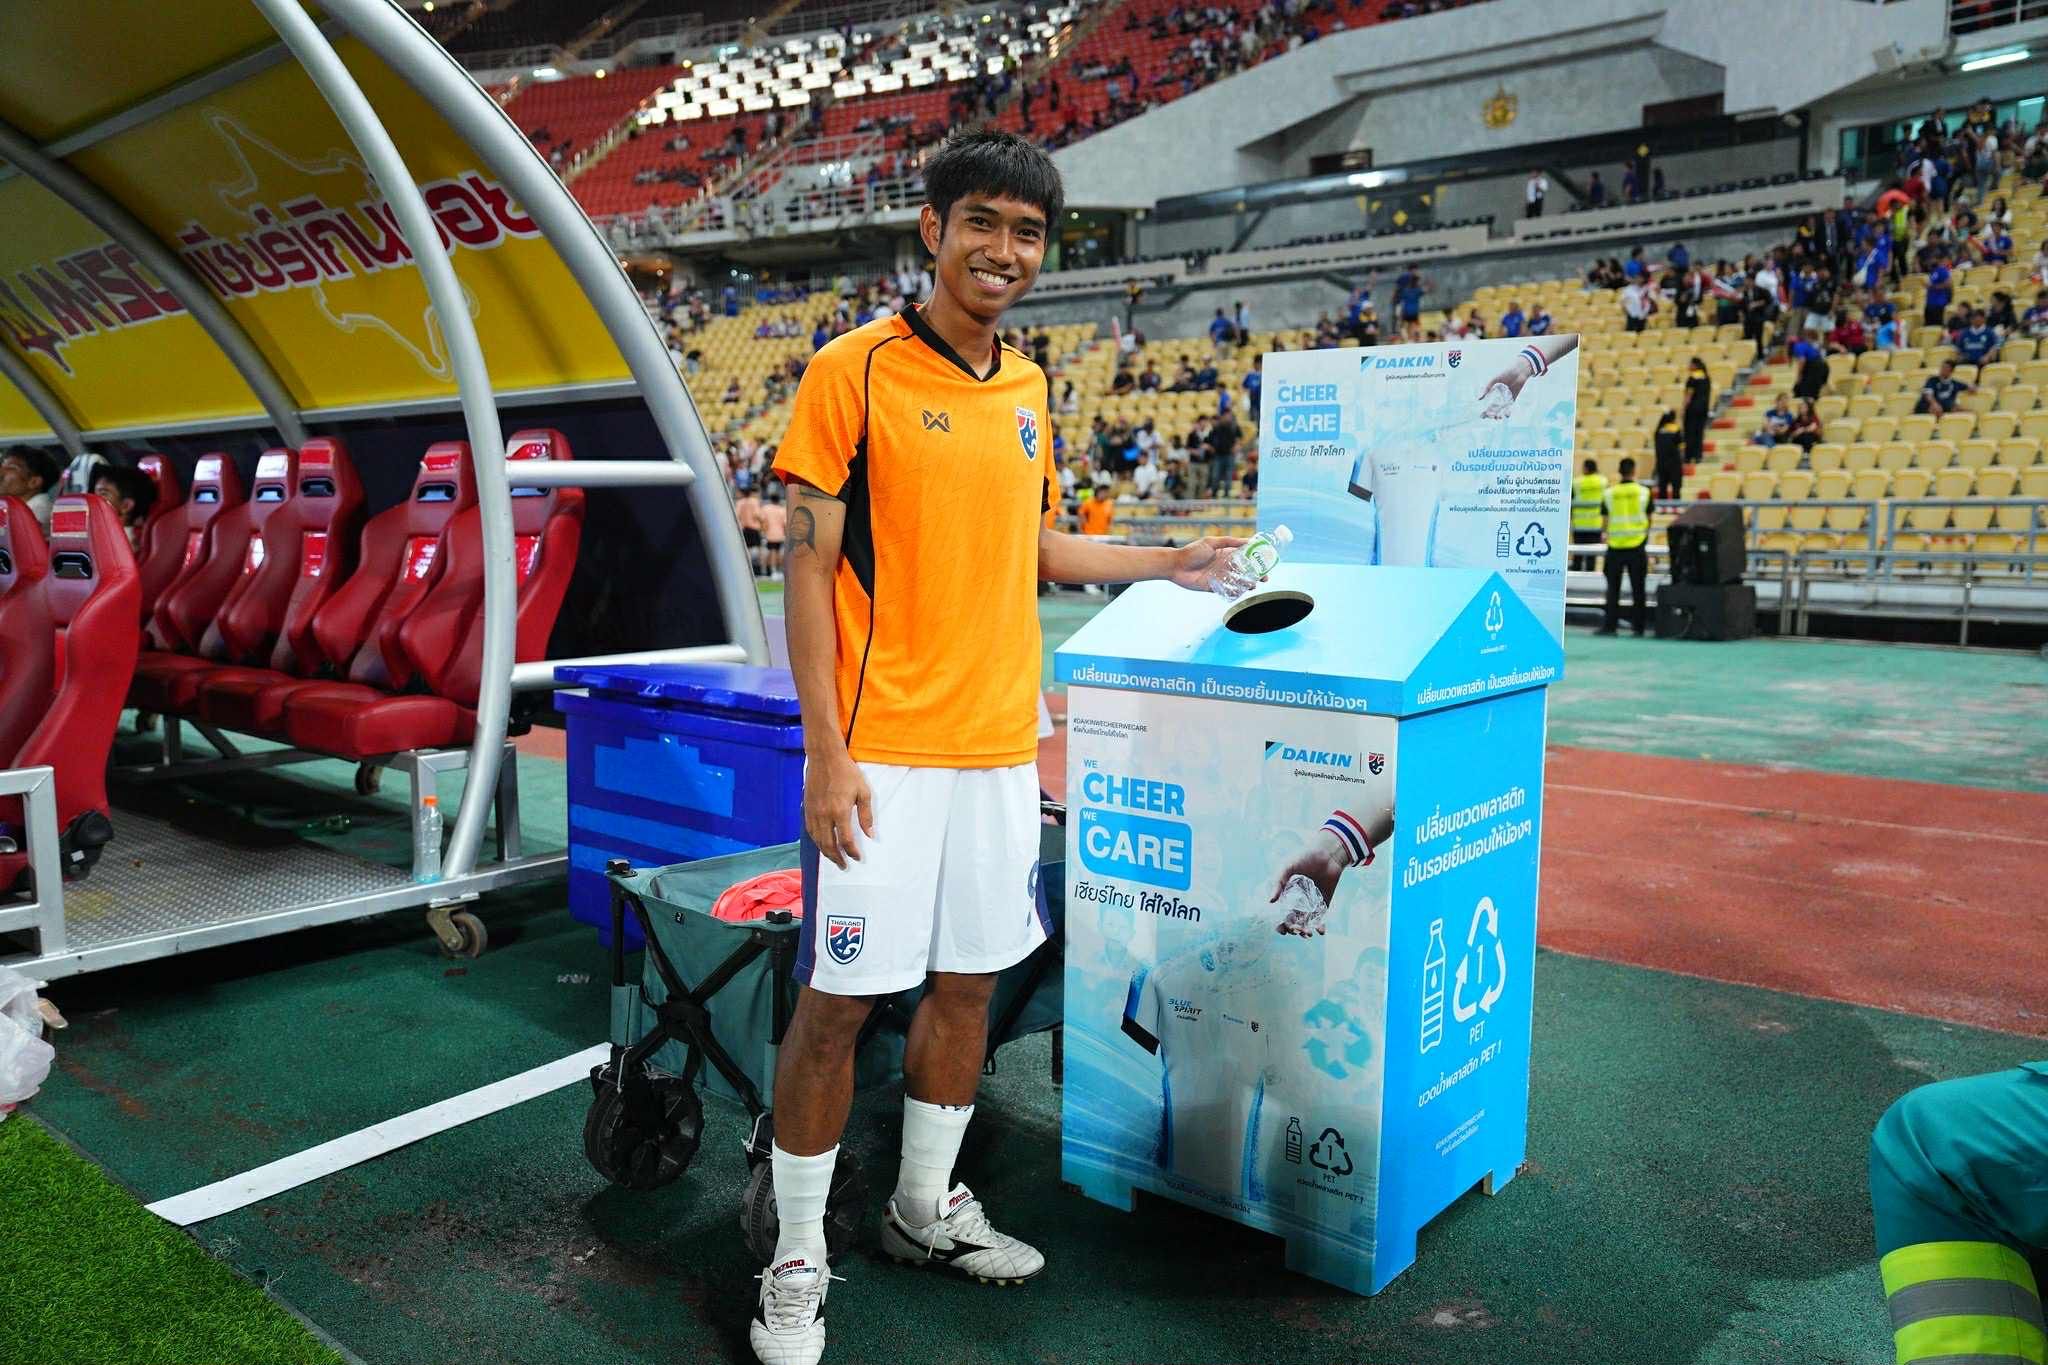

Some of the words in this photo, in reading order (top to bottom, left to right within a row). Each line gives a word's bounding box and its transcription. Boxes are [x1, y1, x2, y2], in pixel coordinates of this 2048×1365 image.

[1376, 356, 1434, 369] DAIKIN
[1278, 384, 1338, 402] CHEER
[1279, 413, 1337, 432] CARE
[1468, 446, 1562, 458] เปลี่ยนขวดพลาสติก
[1072, 664, 1196, 693] เปลี่ยนขวดพลาสติก
[1201, 678, 1368, 711] เป็นรอยยิ้มมอบให้น้องๆ
[1417, 682, 1486, 704] เปลี่ยนขวดพลาสติก
[1084, 759, 1098, 768] WE
[1282, 747, 1352, 768] DAIKIN
[1083, 772, 1185, 816] CHEER
[1083, 811, 1097, 821] WE
[1416, 786, 1525, 844] เปลี่ยนขวดพลาสติก
[1086, 825, 1184, 873] CARE
[1403, 819, 1532, 888] เป็นรอยยิ้มมอบให้น้องๆ
[1074, 881, 1134, 909] เชียร์ไทย
[1140, 891, 1201, 922] ใส่ใจโลก
[1174, 1006, 1202, 1016] SPIRIT
[1469, 1020, 1486, 1045] PET
[1418, 1057, 1478, 1107] ขวดน้ำพลาสติก
[1480, 1042, 1496, 1066] PET
